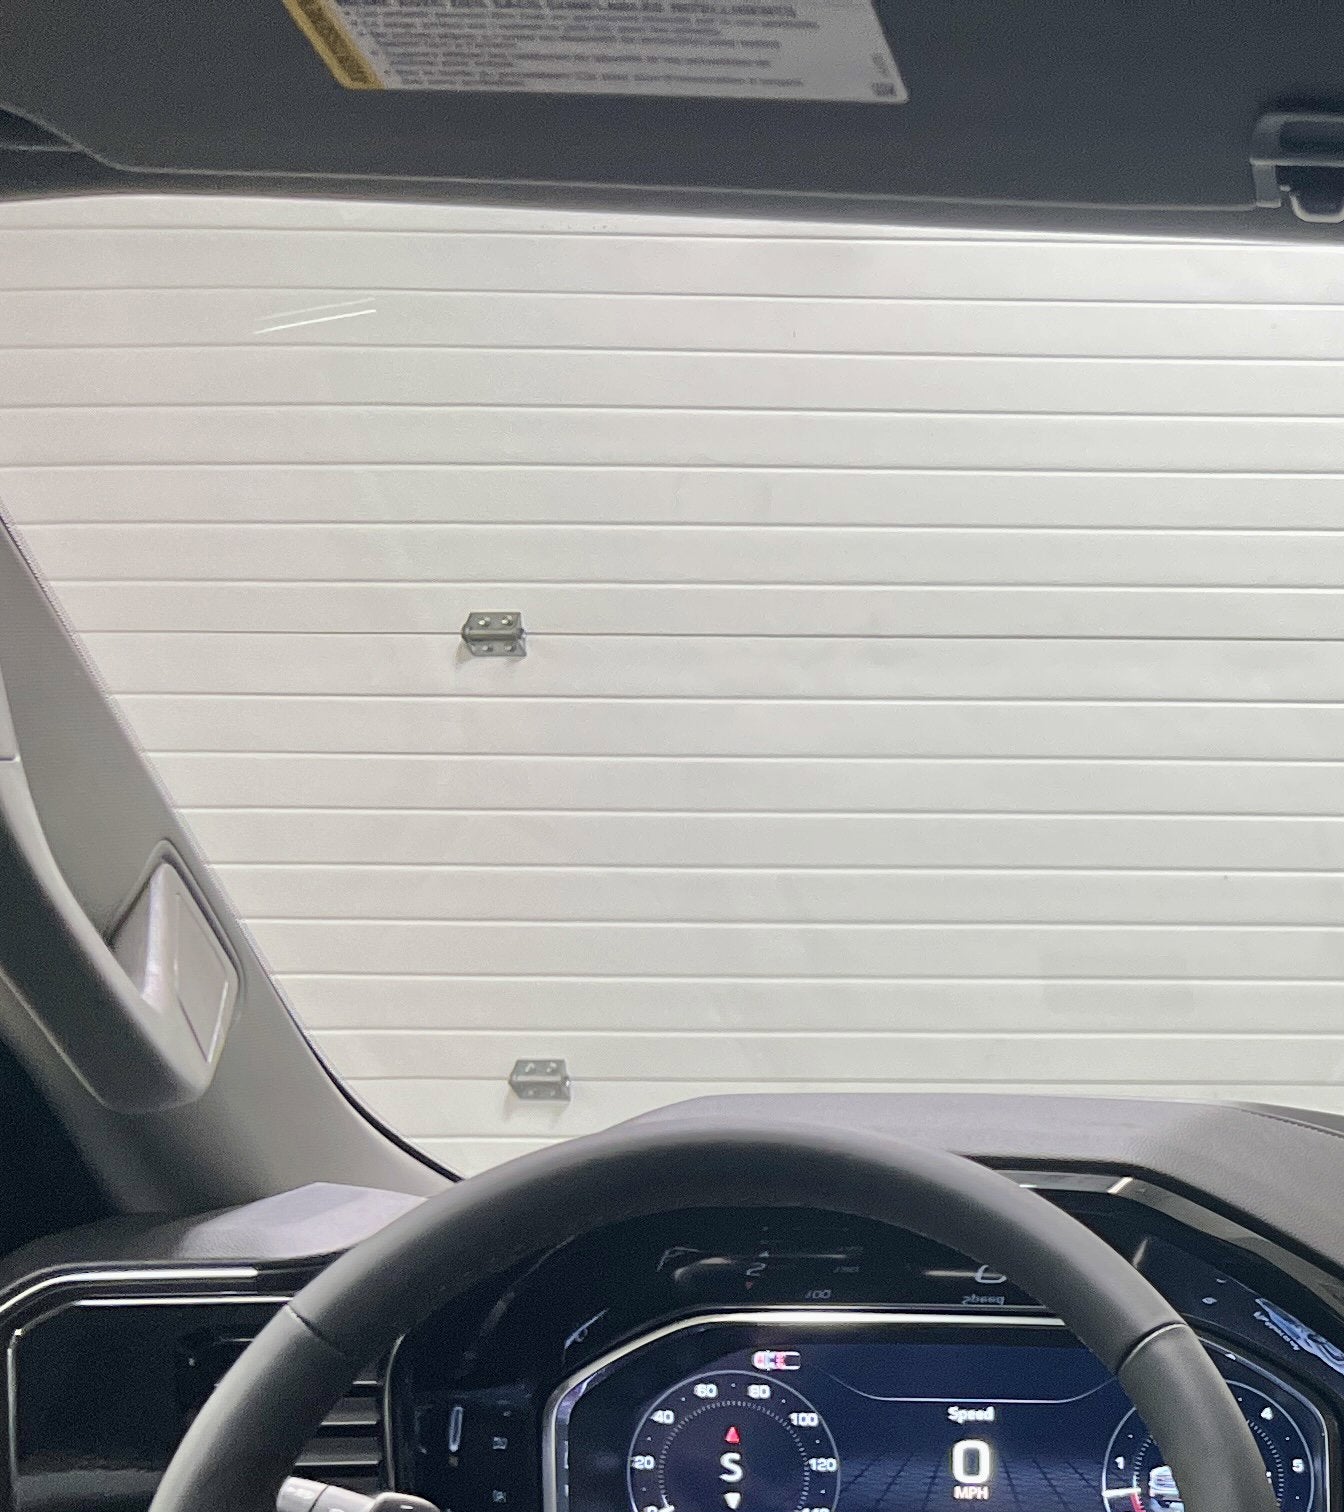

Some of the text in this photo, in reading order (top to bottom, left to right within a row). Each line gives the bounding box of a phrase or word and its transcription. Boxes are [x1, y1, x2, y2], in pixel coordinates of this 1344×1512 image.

[693, 1383, 719, 1398] 60
[747, 1384, 771, 1399] 80
[650, 1409, 675, 1425] 40
[789, 1411, 820, 1427] 100
[947, 1405, 996, 1425] Speed
[1260, 1405, 1275, 1421] 4
[631, 1454, 655, 1470] 20
[718, 1451, 744, 1483] S
[808, 1457, 838, 1472] 120
[952, 1439, 991, 1484] 0
[1114, 1456, 1125, 1470] 1
[1291, 1458, 1305, 1474] 5
[953, 1485, 989, 1500] MPH
